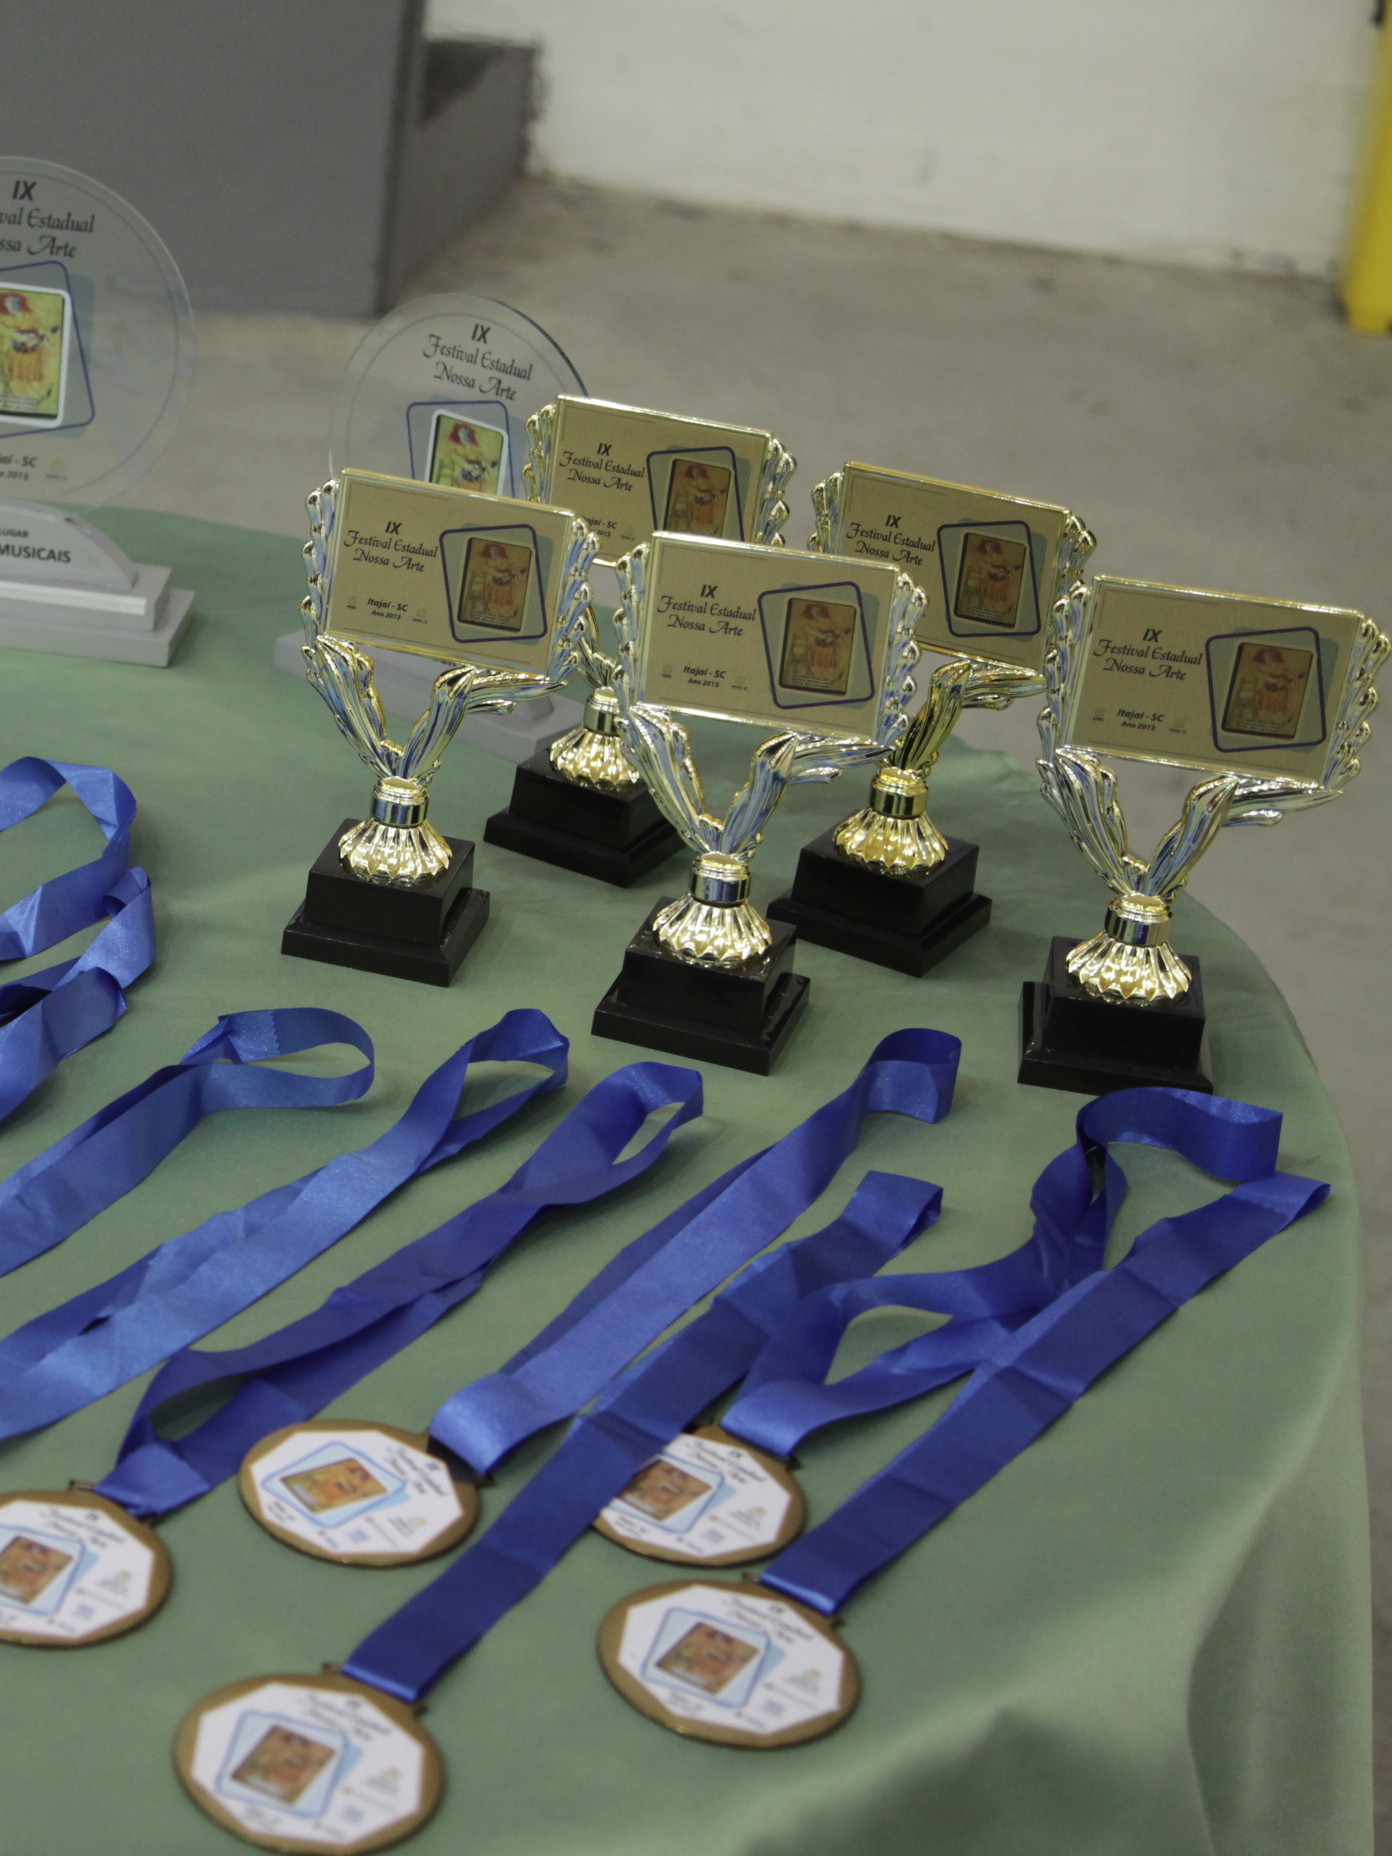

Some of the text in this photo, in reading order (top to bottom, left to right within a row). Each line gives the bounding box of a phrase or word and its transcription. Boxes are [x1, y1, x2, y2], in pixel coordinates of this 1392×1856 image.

[12, 180, 37, 201] IX
[27, 208, 96, 233] Estadual
[27, 235, 77, 258] Arte
[471, 323, 491, 344] IX
[423, 334, 533, 381] Festival Estadual
[433, 361, 517, 401] Nossa Arte
[597, 442, 613, 456] IX
[21, 456, 38, 468] SC
[559, 451, 645, 478] Festival Estadual
[568, 468, 633, 492] Nossa Arte
[385, 521, 402, 535] IX
[606, 520, 617, 529] SC
[885, 514, 902, 529] IX
[344, 530, 438, 558] Festival Estadual
[846, 522, 936, 552] Festival Estadual
[353, 548, 425, 572] Nossa Arte
[855, 540, 924, 566] Nossa Arte
[700, 585, 718, 599] IX
[385, 612, 401, 620] 2013
[396, 603, 408, 612] SC
[657, 595, 757, 621] Festival Estadual
[666, 614, 743, 636] Nossa Arte
[1142, 628, 1163, 643] IX
[1093, 639, 1203, 665] Festival Estadual
[714, 670, 727, 679] SC
[1103, 657, 1187, 681] Nossa Arte
[702, 680, 720, 688] 2013
[1137, 723, 1156, 732] 2013
[1151, 713, 1165, 723] SC
